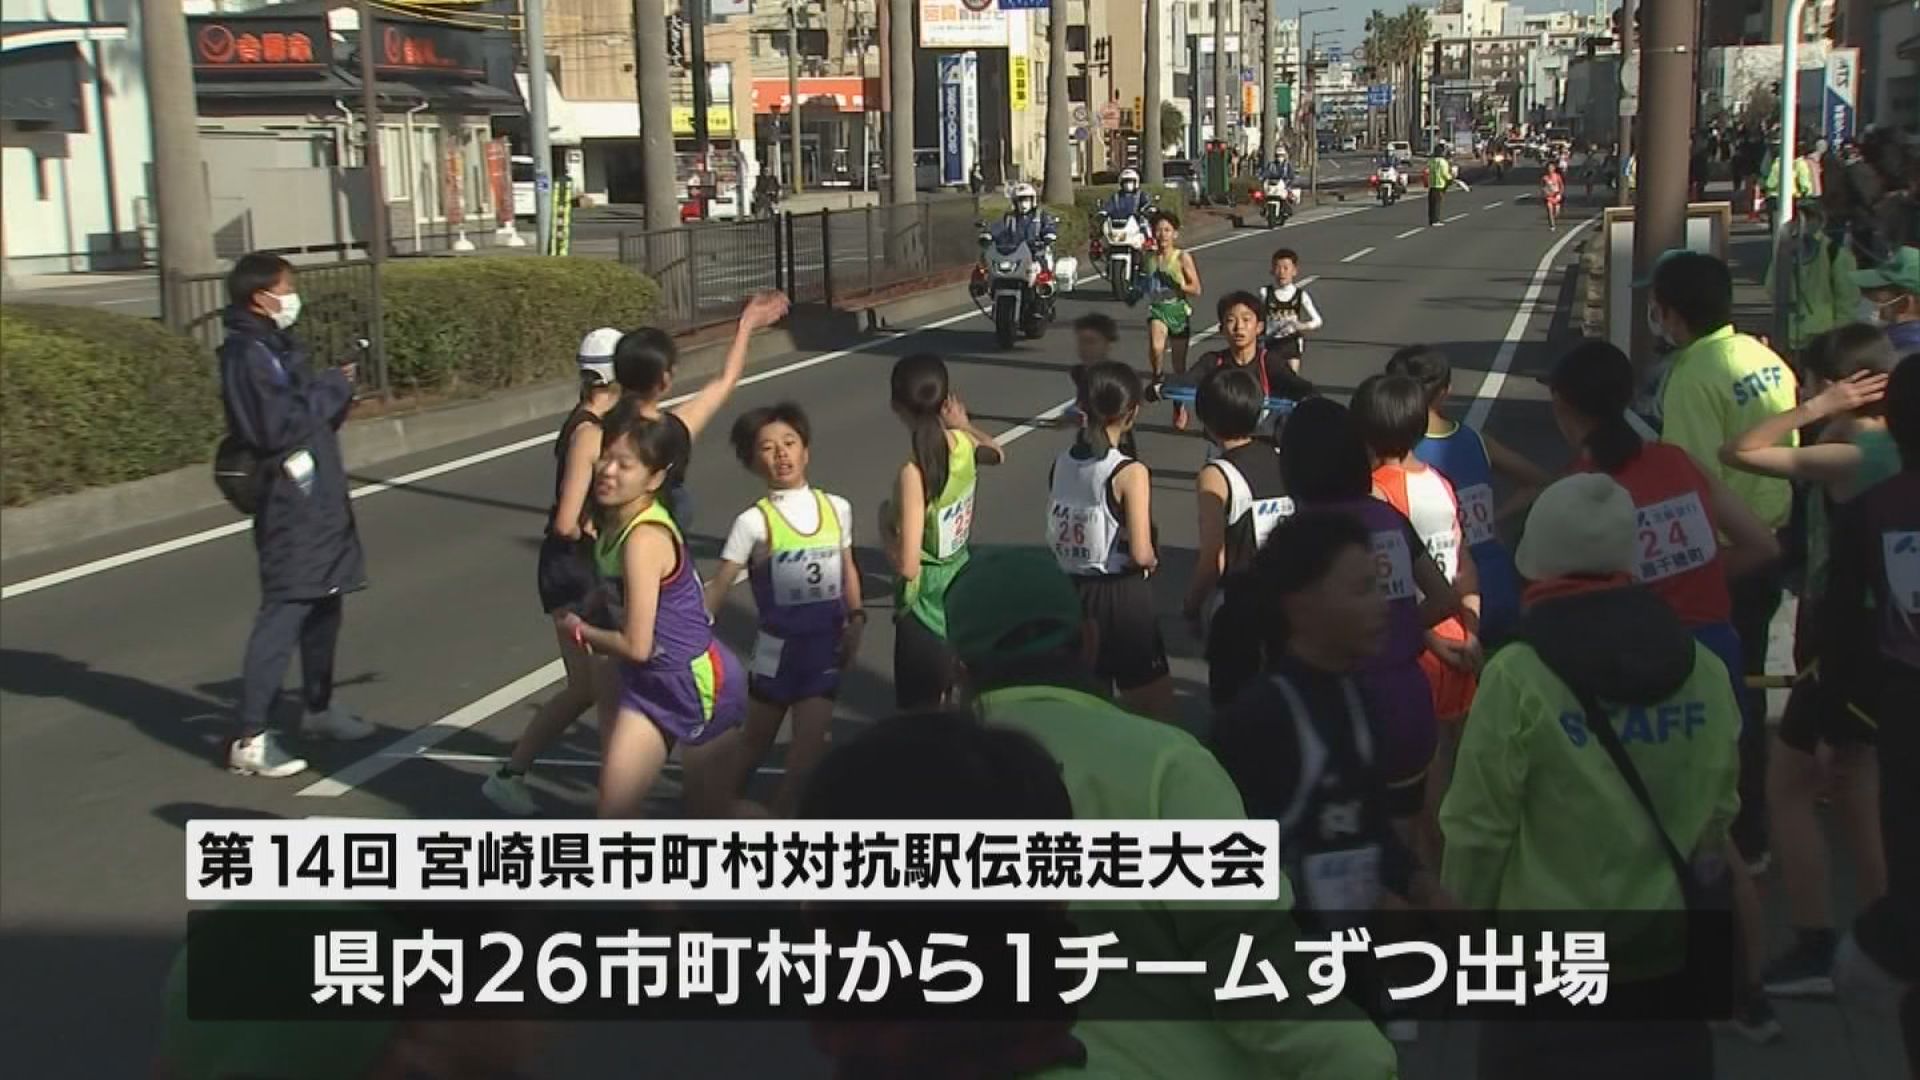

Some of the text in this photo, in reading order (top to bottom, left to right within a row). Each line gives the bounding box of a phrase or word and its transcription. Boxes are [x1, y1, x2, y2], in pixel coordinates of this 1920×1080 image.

[1732, 365, 1781, 406] STAFF
[1059, 520, 1085, 544] 26
[1639, 519, 1688, 561] 24
[806, 562, 822, 585] 3
